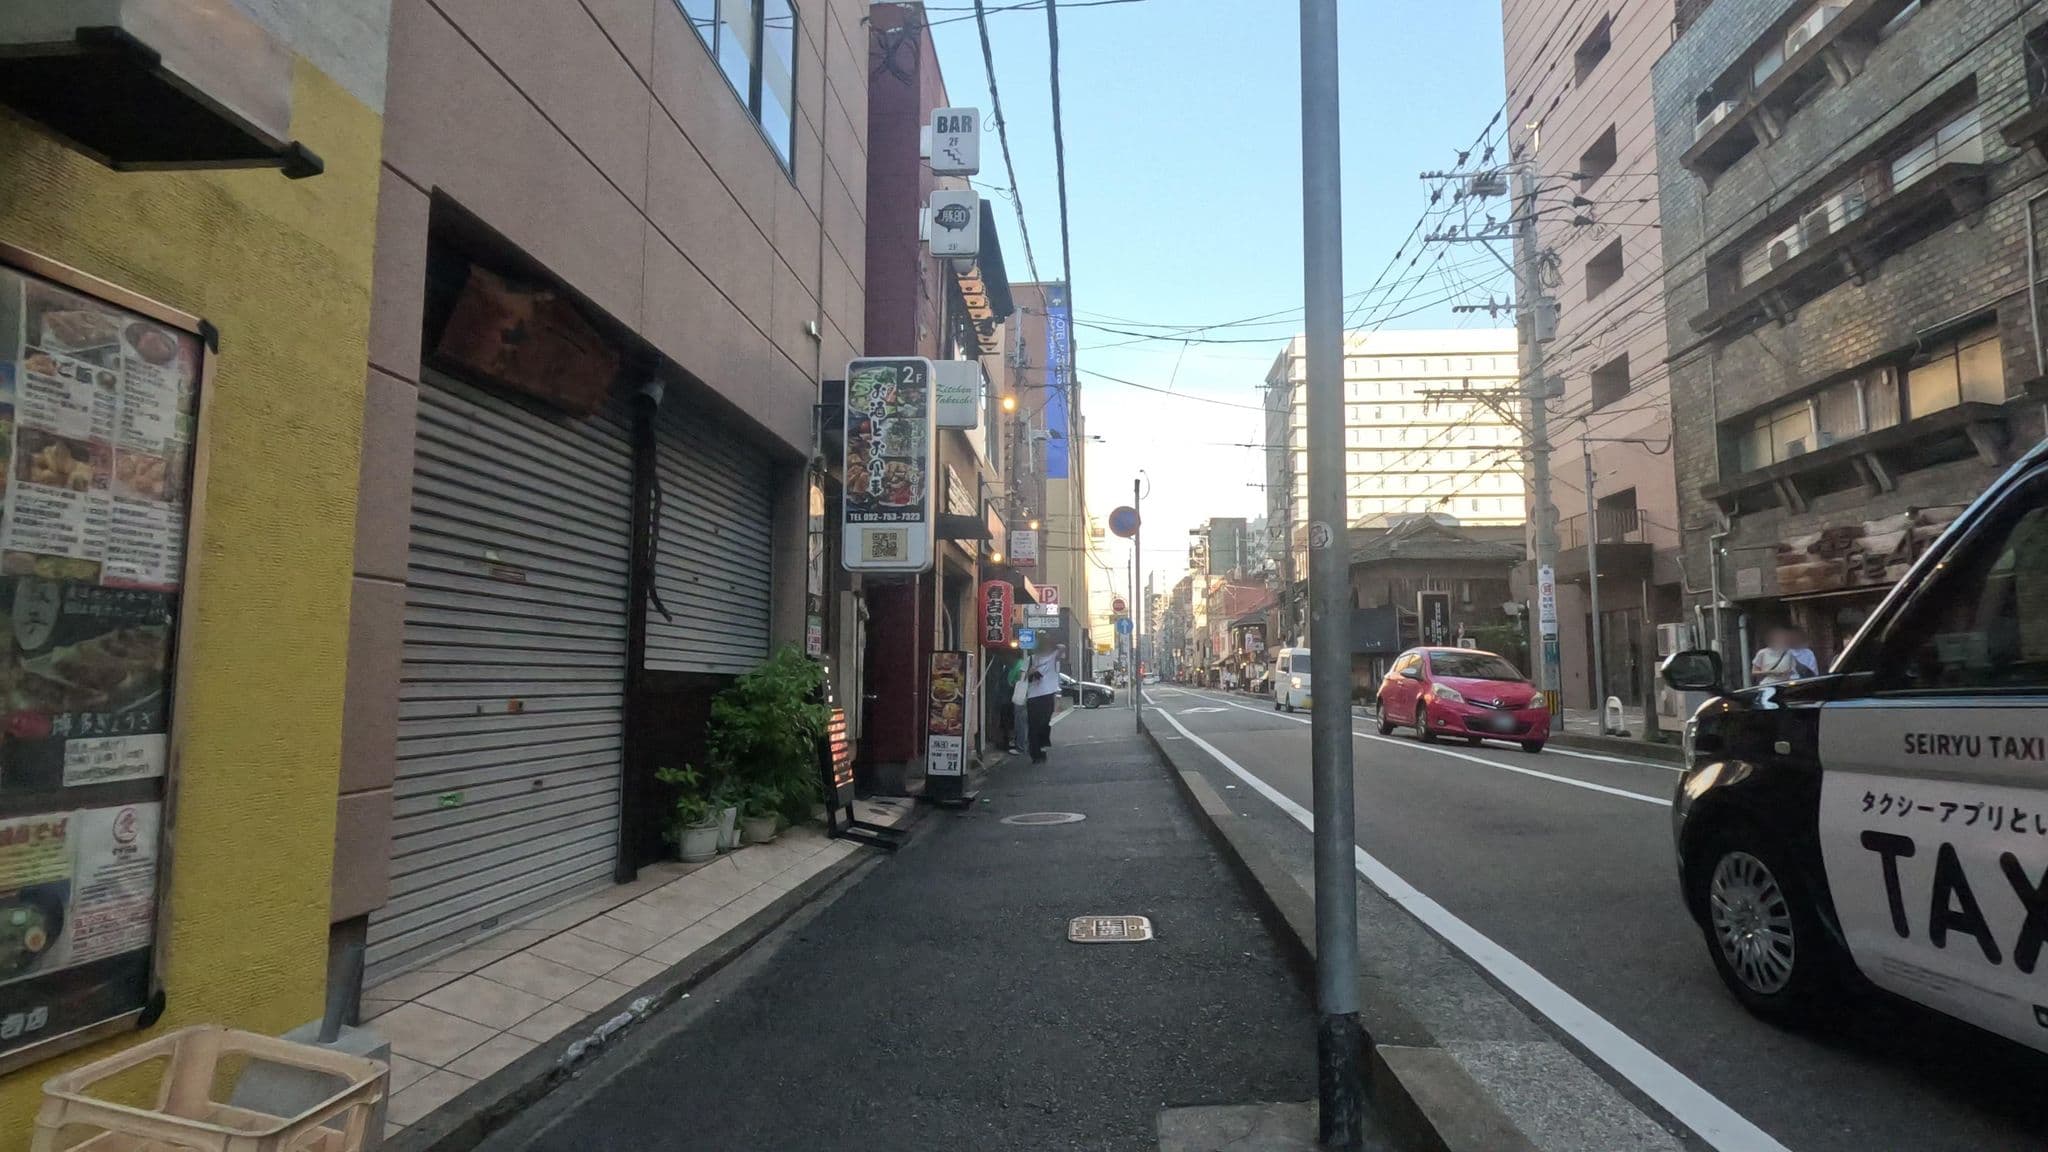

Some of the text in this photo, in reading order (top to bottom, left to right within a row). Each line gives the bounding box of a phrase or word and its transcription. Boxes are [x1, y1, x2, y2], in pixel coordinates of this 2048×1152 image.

[937, 115, 972, 133] BAR
[948, 137, 959, 147] 2F
[902, 366, 922, 384] 2F
[868, 383, 886, 496] お酒とお食事
[849, 513, 861, 521] TEL
[1042, 588, 1058, 603] P
[1905, 733, 2044, 760] SEIRYU TAXI
